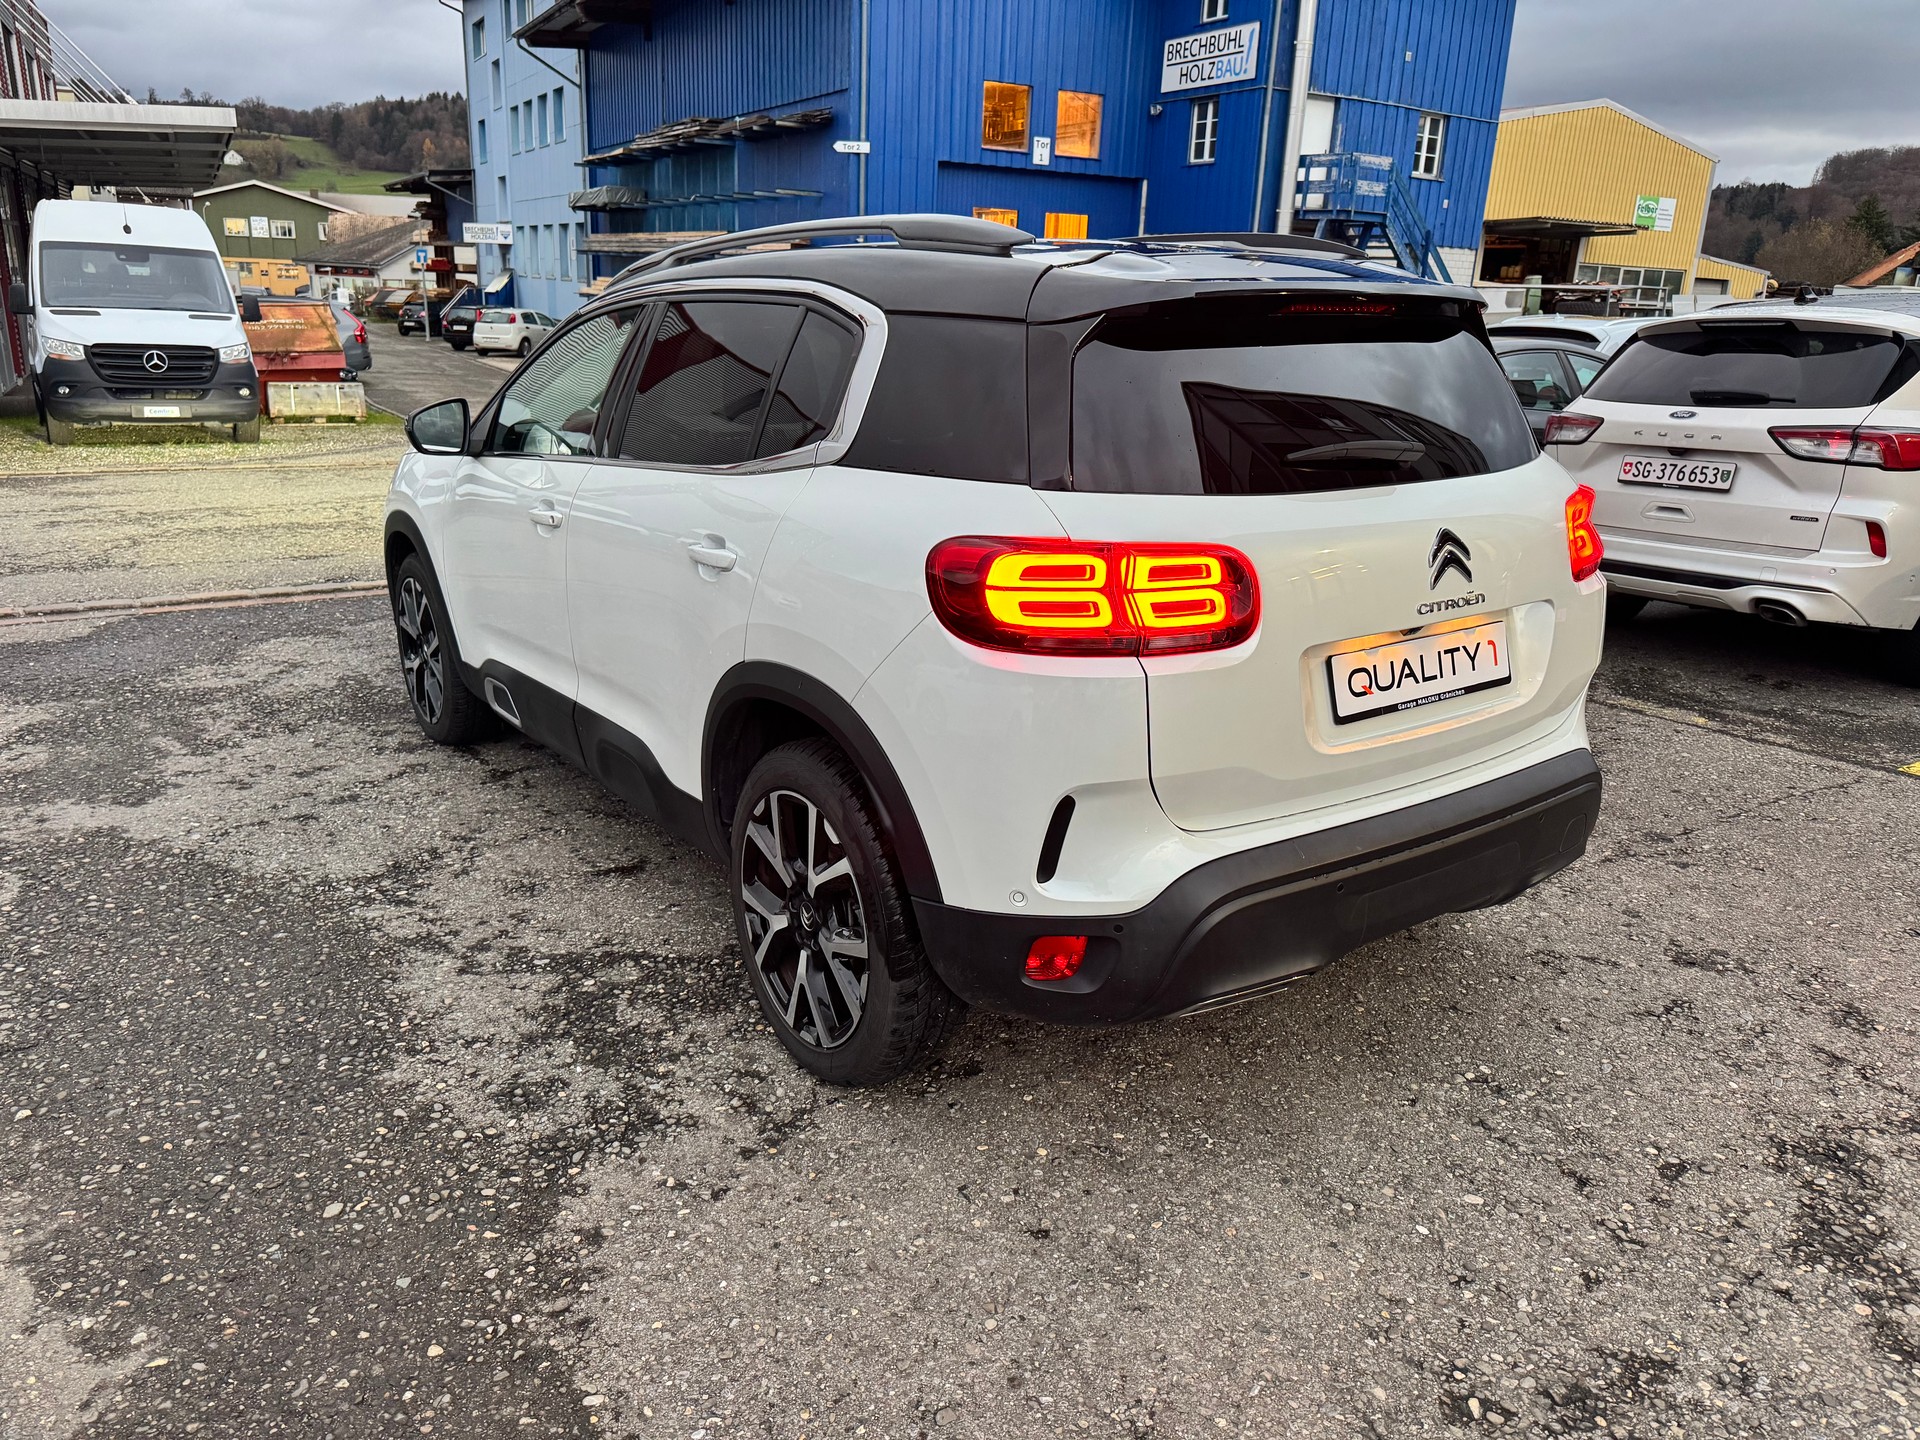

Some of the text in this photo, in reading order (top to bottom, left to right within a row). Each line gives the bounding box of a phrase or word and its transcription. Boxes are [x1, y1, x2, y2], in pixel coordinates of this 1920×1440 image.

[1166, 29, 1244, 62] BRECHBÜHL
[842, 143, 855, 151] Tor
[1035, 139, 1049, 149] Tor
[1038, 153, 1043, 162] 1
[1634, 429, 1722, 441] KUGA
[1347, 641, 1481, 698] QUALITY
[1397, 701, 1417, 710] Garage
[1417, 695, 1439, 705] MALOKU
